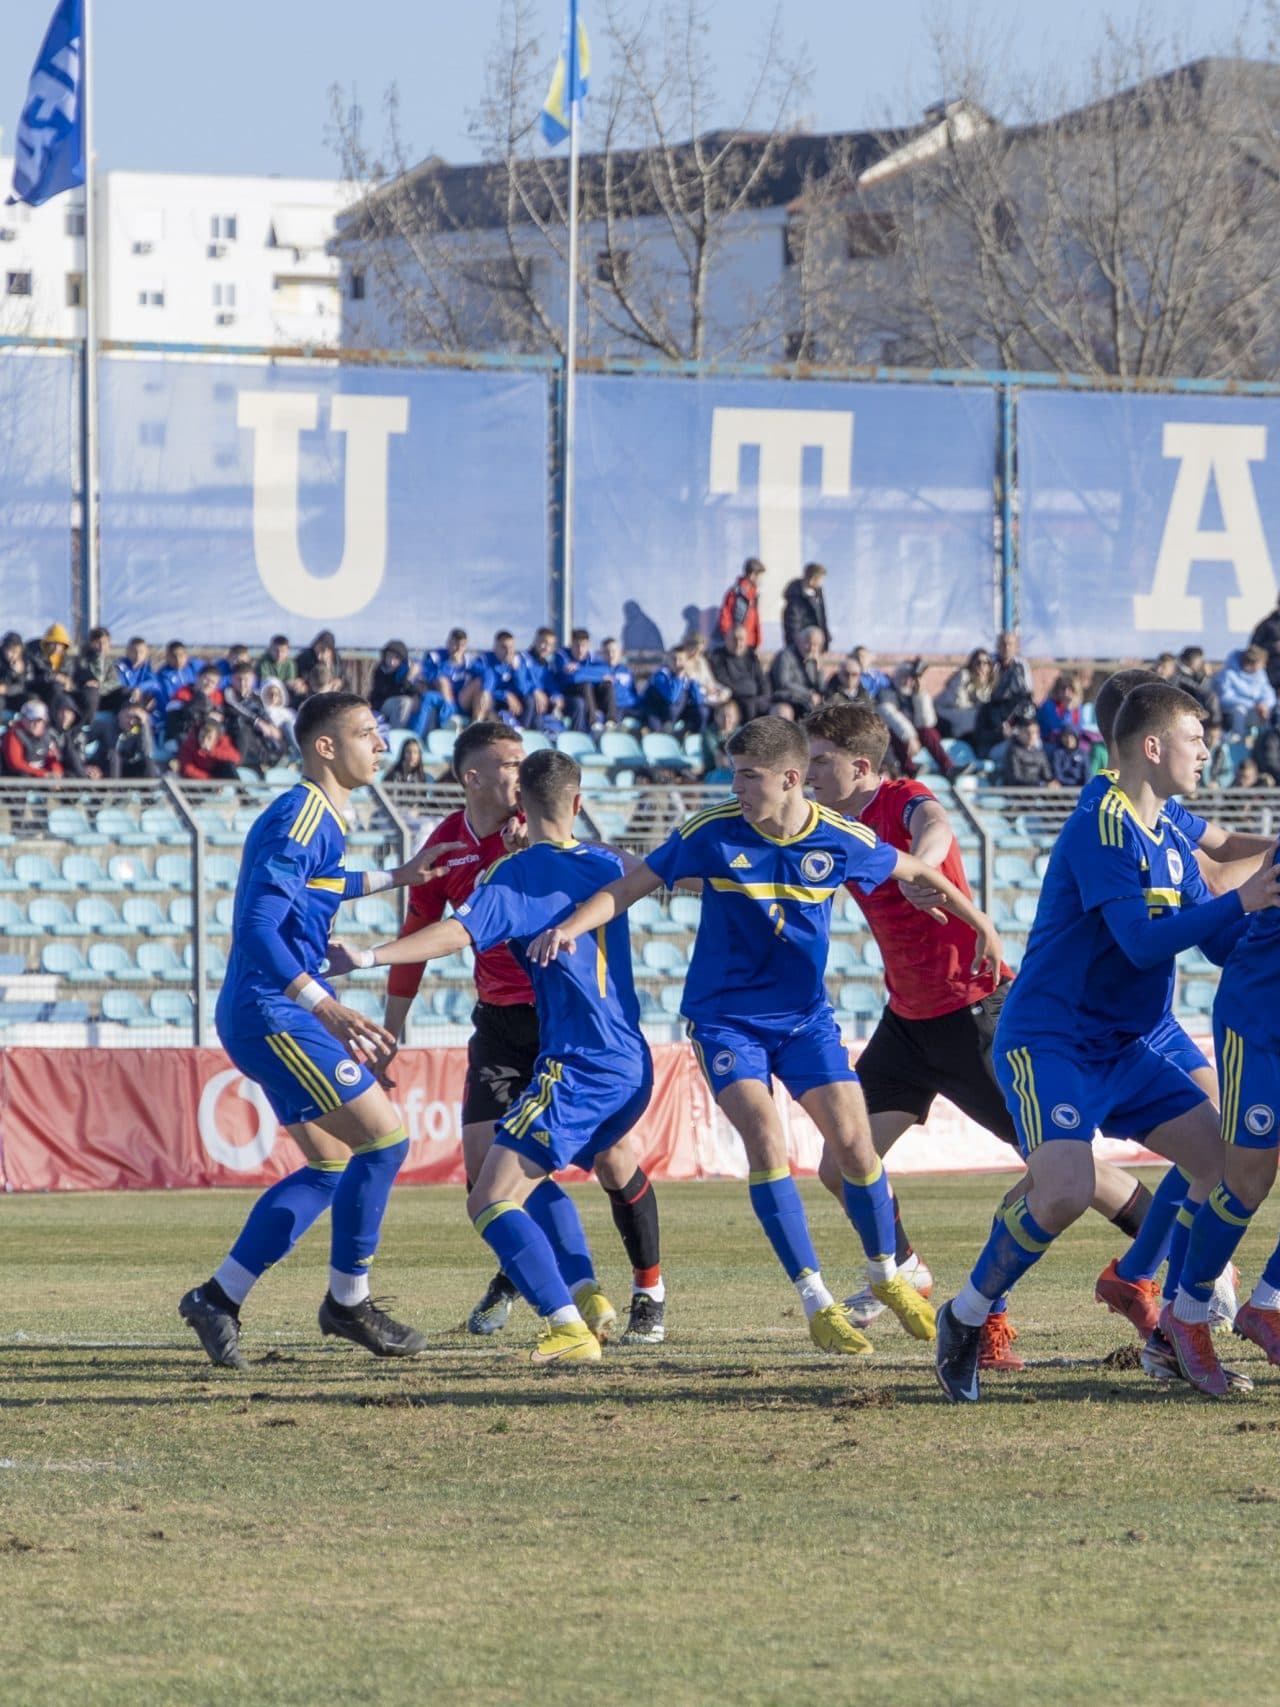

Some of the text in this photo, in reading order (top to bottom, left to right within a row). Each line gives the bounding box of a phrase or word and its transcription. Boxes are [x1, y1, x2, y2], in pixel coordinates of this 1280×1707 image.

[236, 391, 1279, 632] U T A
[768, 903, 788, 942] 2
